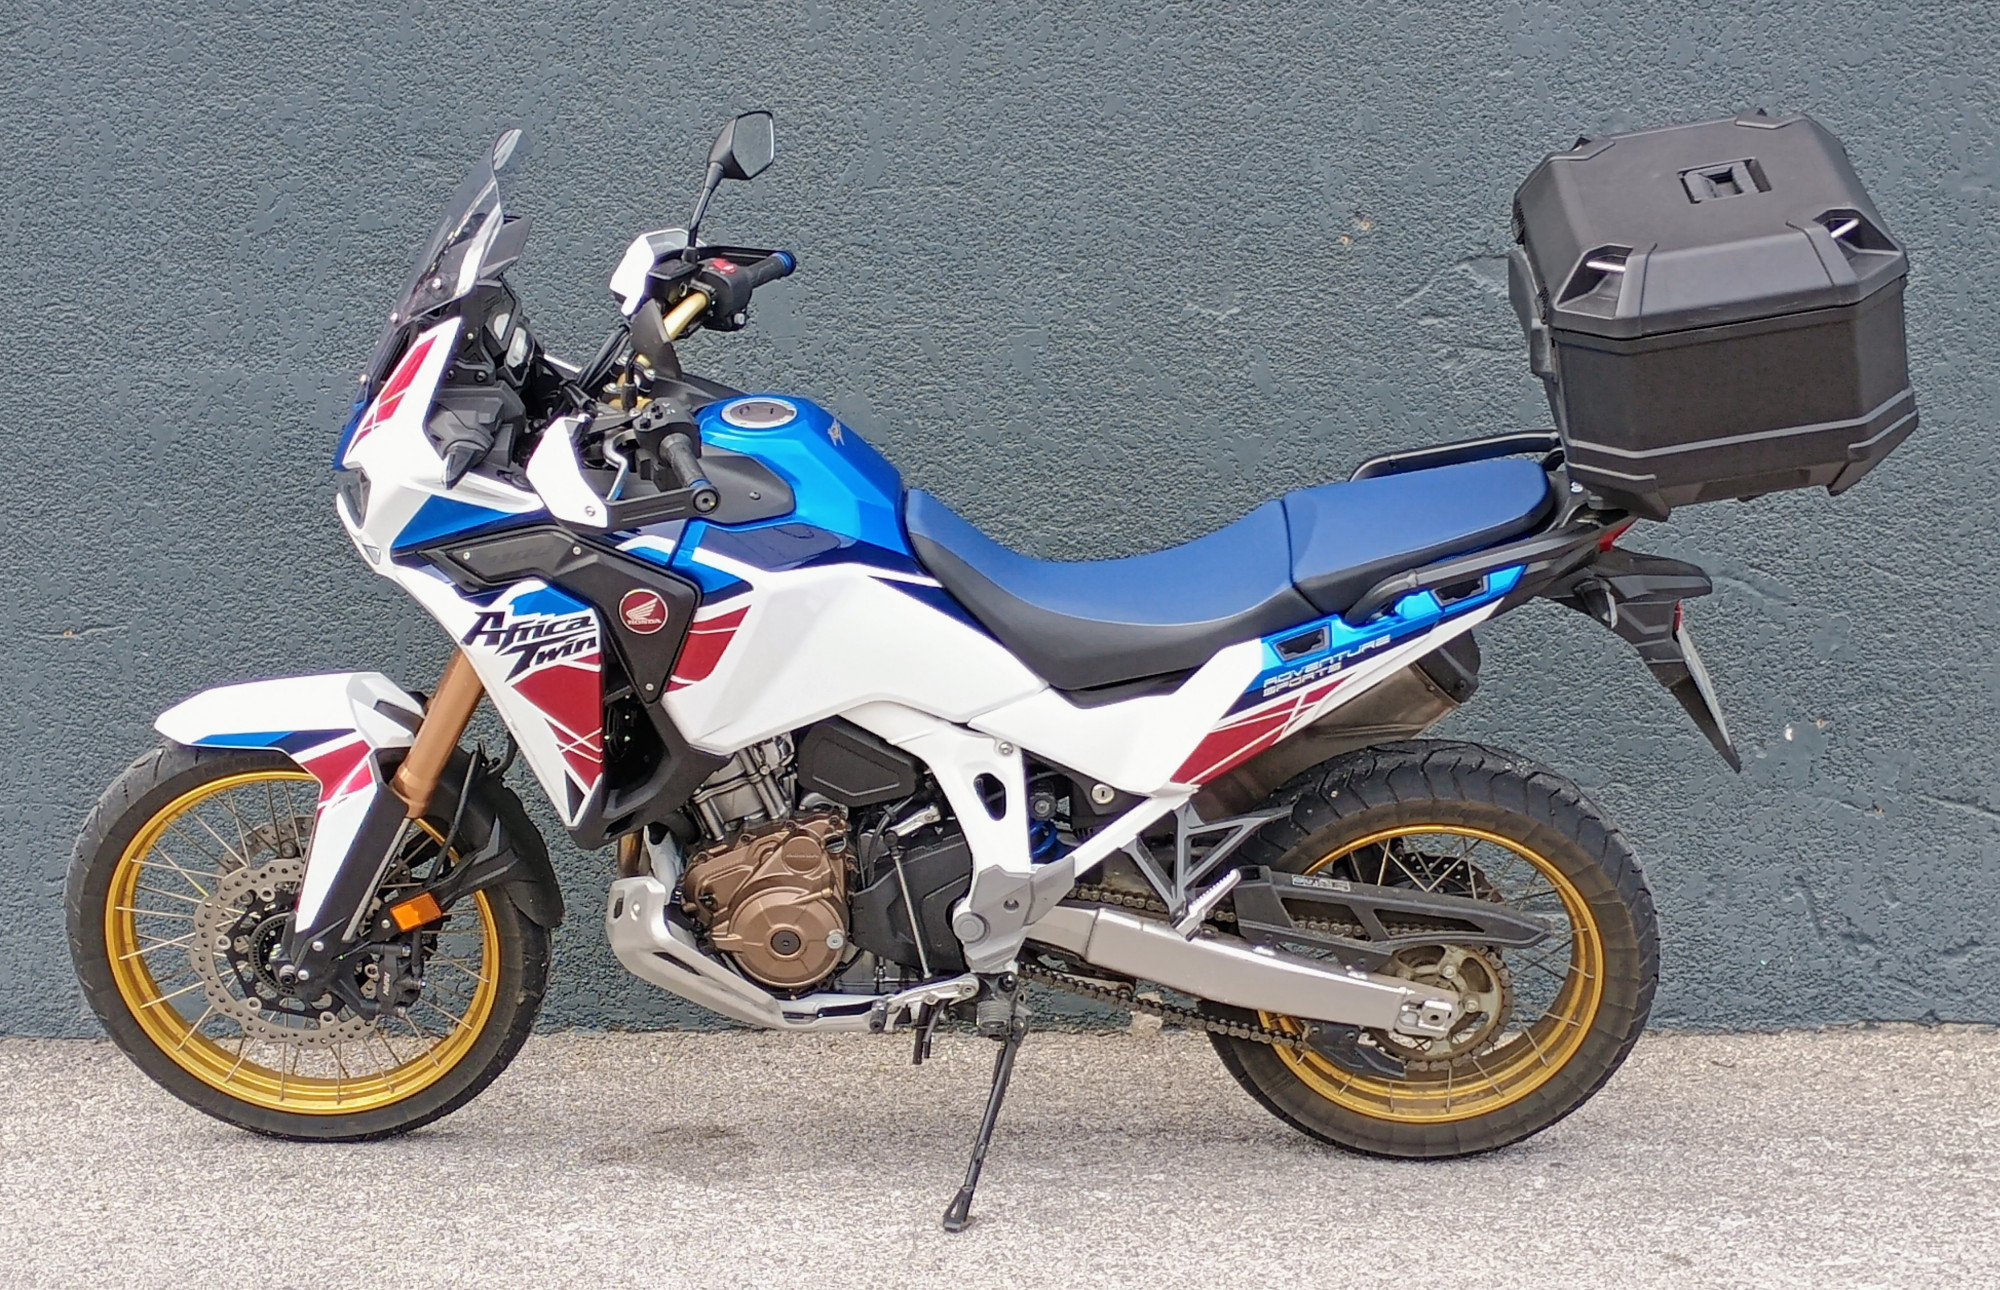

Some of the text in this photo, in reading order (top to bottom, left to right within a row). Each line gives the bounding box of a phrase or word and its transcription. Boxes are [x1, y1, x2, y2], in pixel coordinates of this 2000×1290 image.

[460, 611, 594, 653] Africa
[501, 633, 597, 682] Twin
[1263, 634, 1391, 688] ADVENTURE
[1263, 661, 1342, 697] SPORTS
